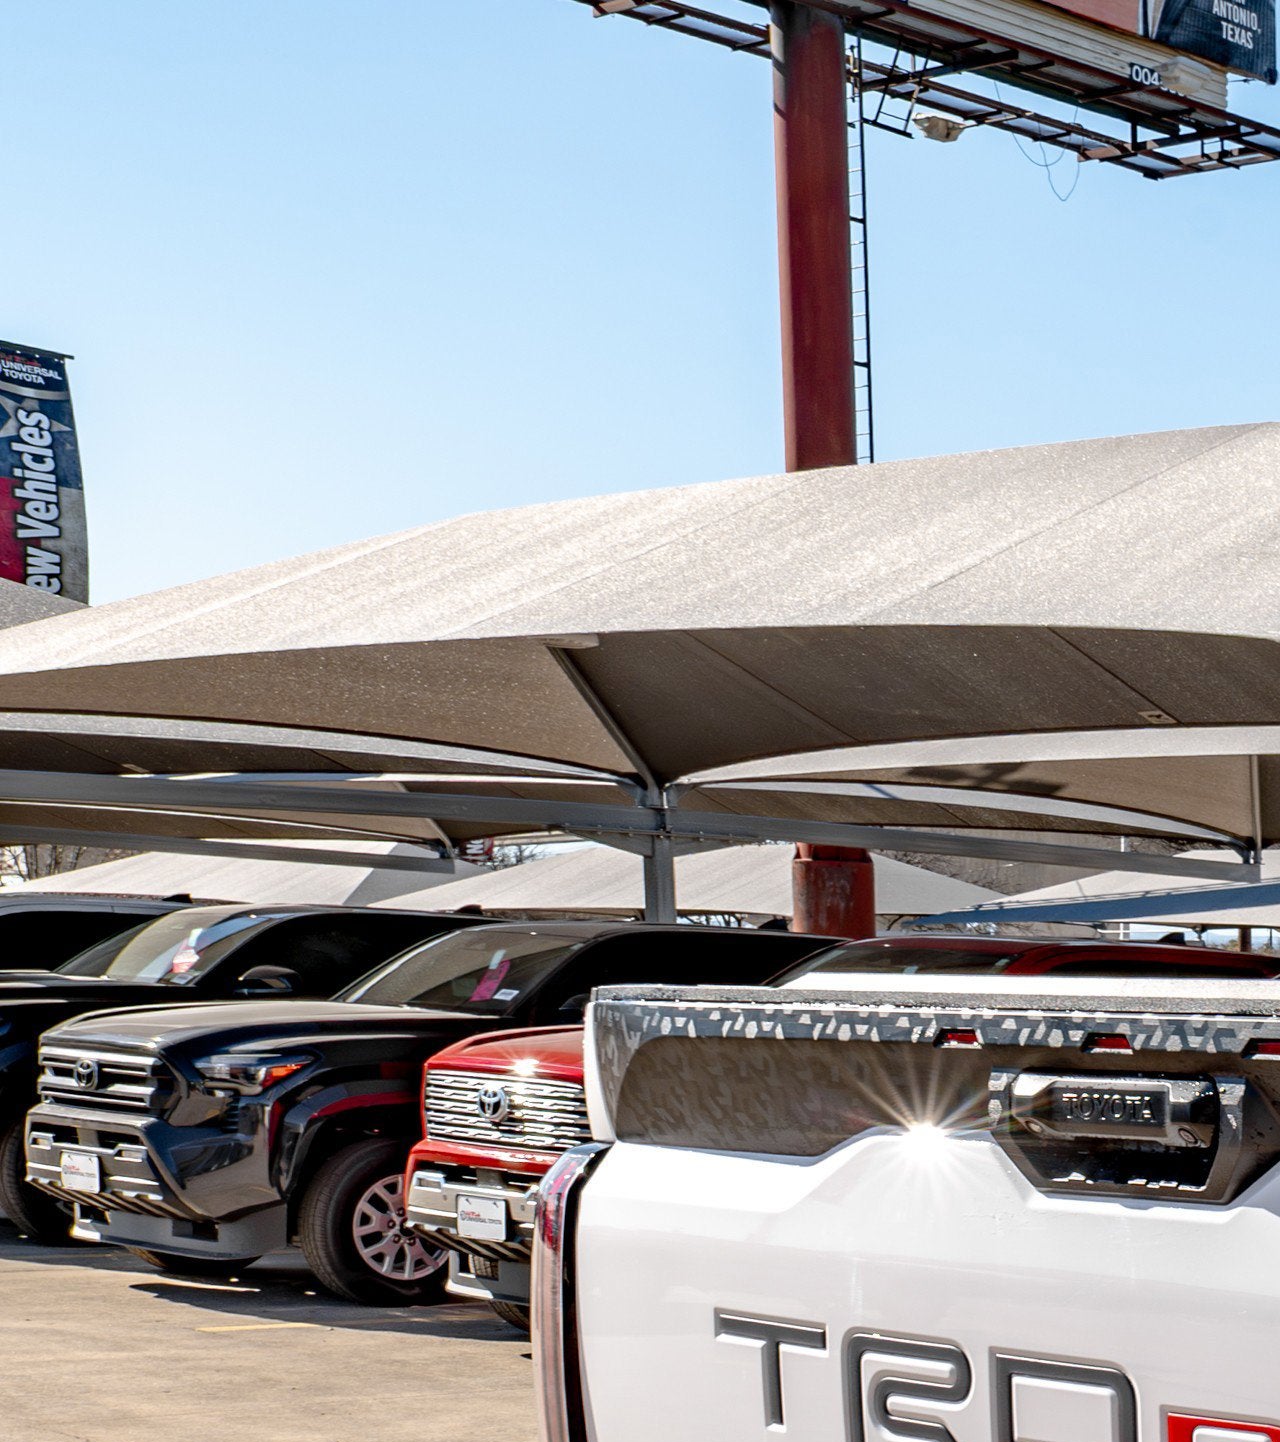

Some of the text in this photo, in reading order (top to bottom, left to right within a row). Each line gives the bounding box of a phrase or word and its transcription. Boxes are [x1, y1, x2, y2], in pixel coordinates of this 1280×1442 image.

[1220, 21, 1253, 49] TEXAS
[1, 359, 63, 380] UNIVERSAL
[3, 368, 46, 385] TOYOTA
[11, 408, 60, 538] Vehicles
[26, 546, 61, 594] ew
[1061, 1092, 1157, 1122] TOYOTA
